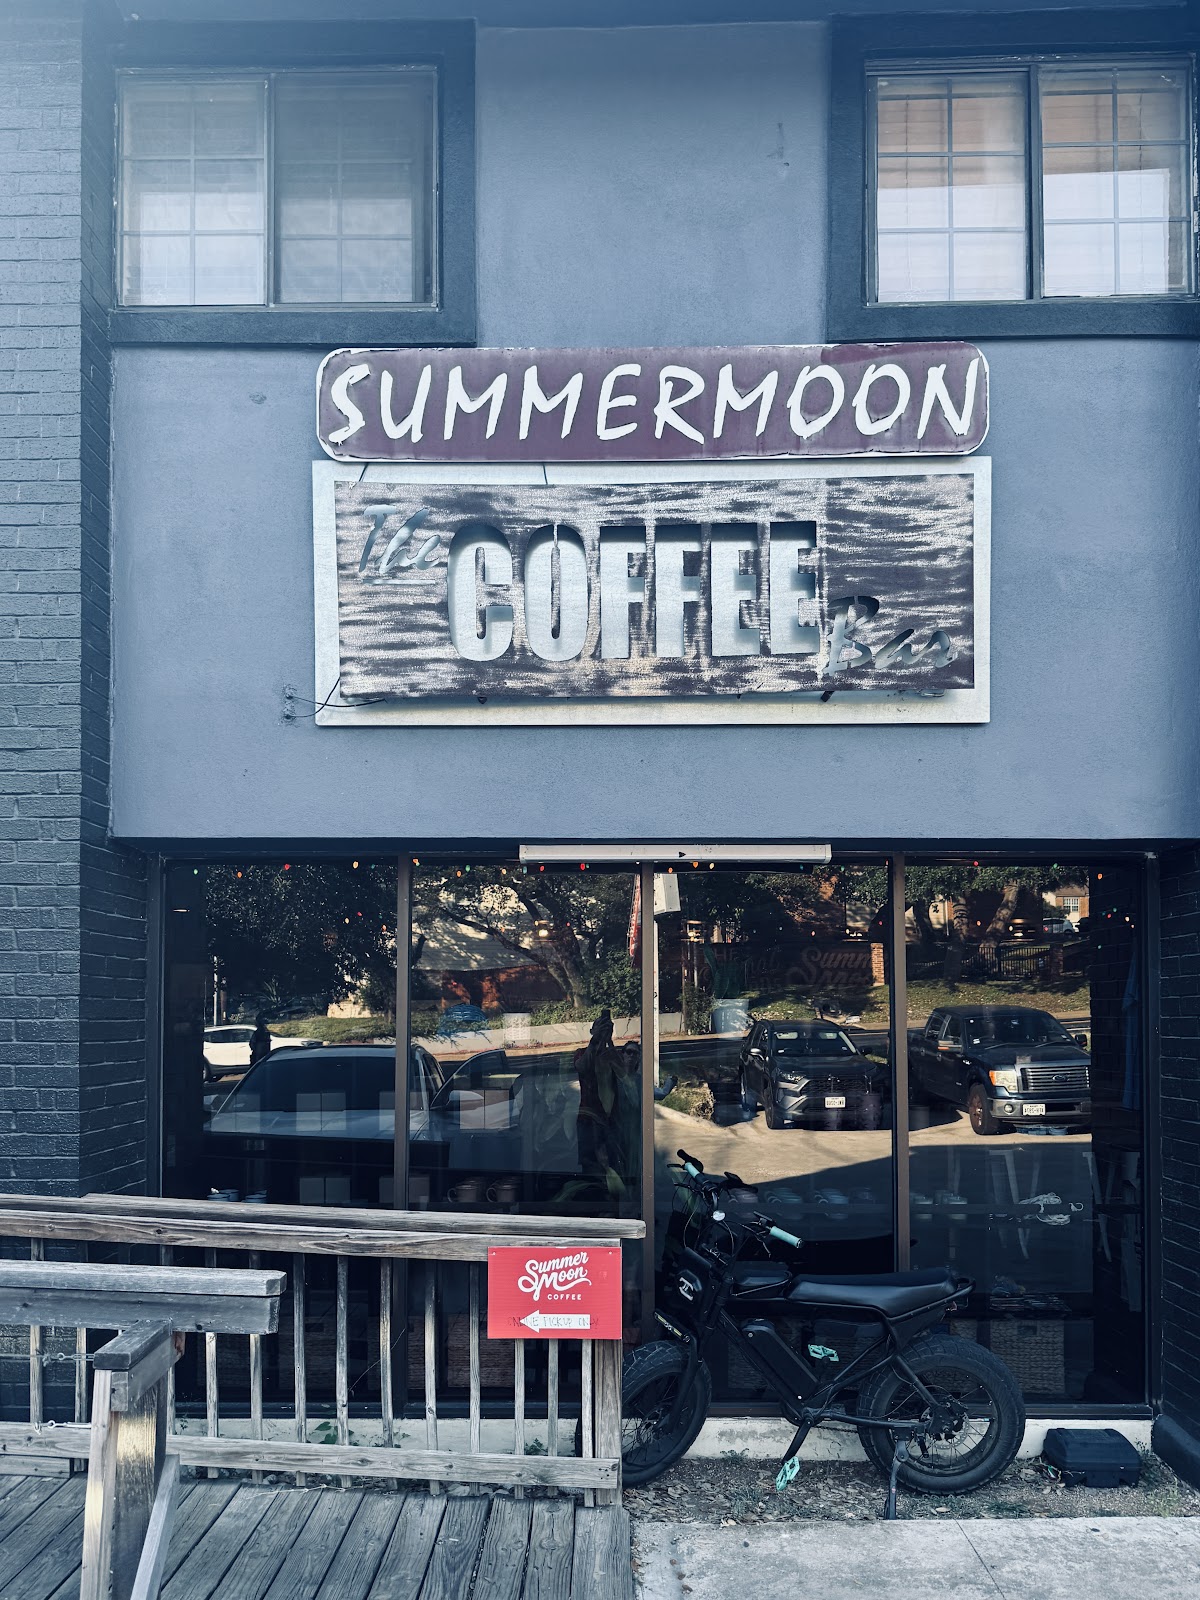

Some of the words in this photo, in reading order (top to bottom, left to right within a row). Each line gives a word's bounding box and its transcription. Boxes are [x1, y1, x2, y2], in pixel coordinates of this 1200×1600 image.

[328, 362, 976, 447] SUMMERMOON
[356, 504, 443, 577] The
[447, 520, 820, 663] COFFEE
[822, 595, 960, 677] Bar
[518, 1251, 590, 1292] Summer
[533, 1266, 592, 1301] Moon
[547, 1293, 582, 1301] COFFEE
